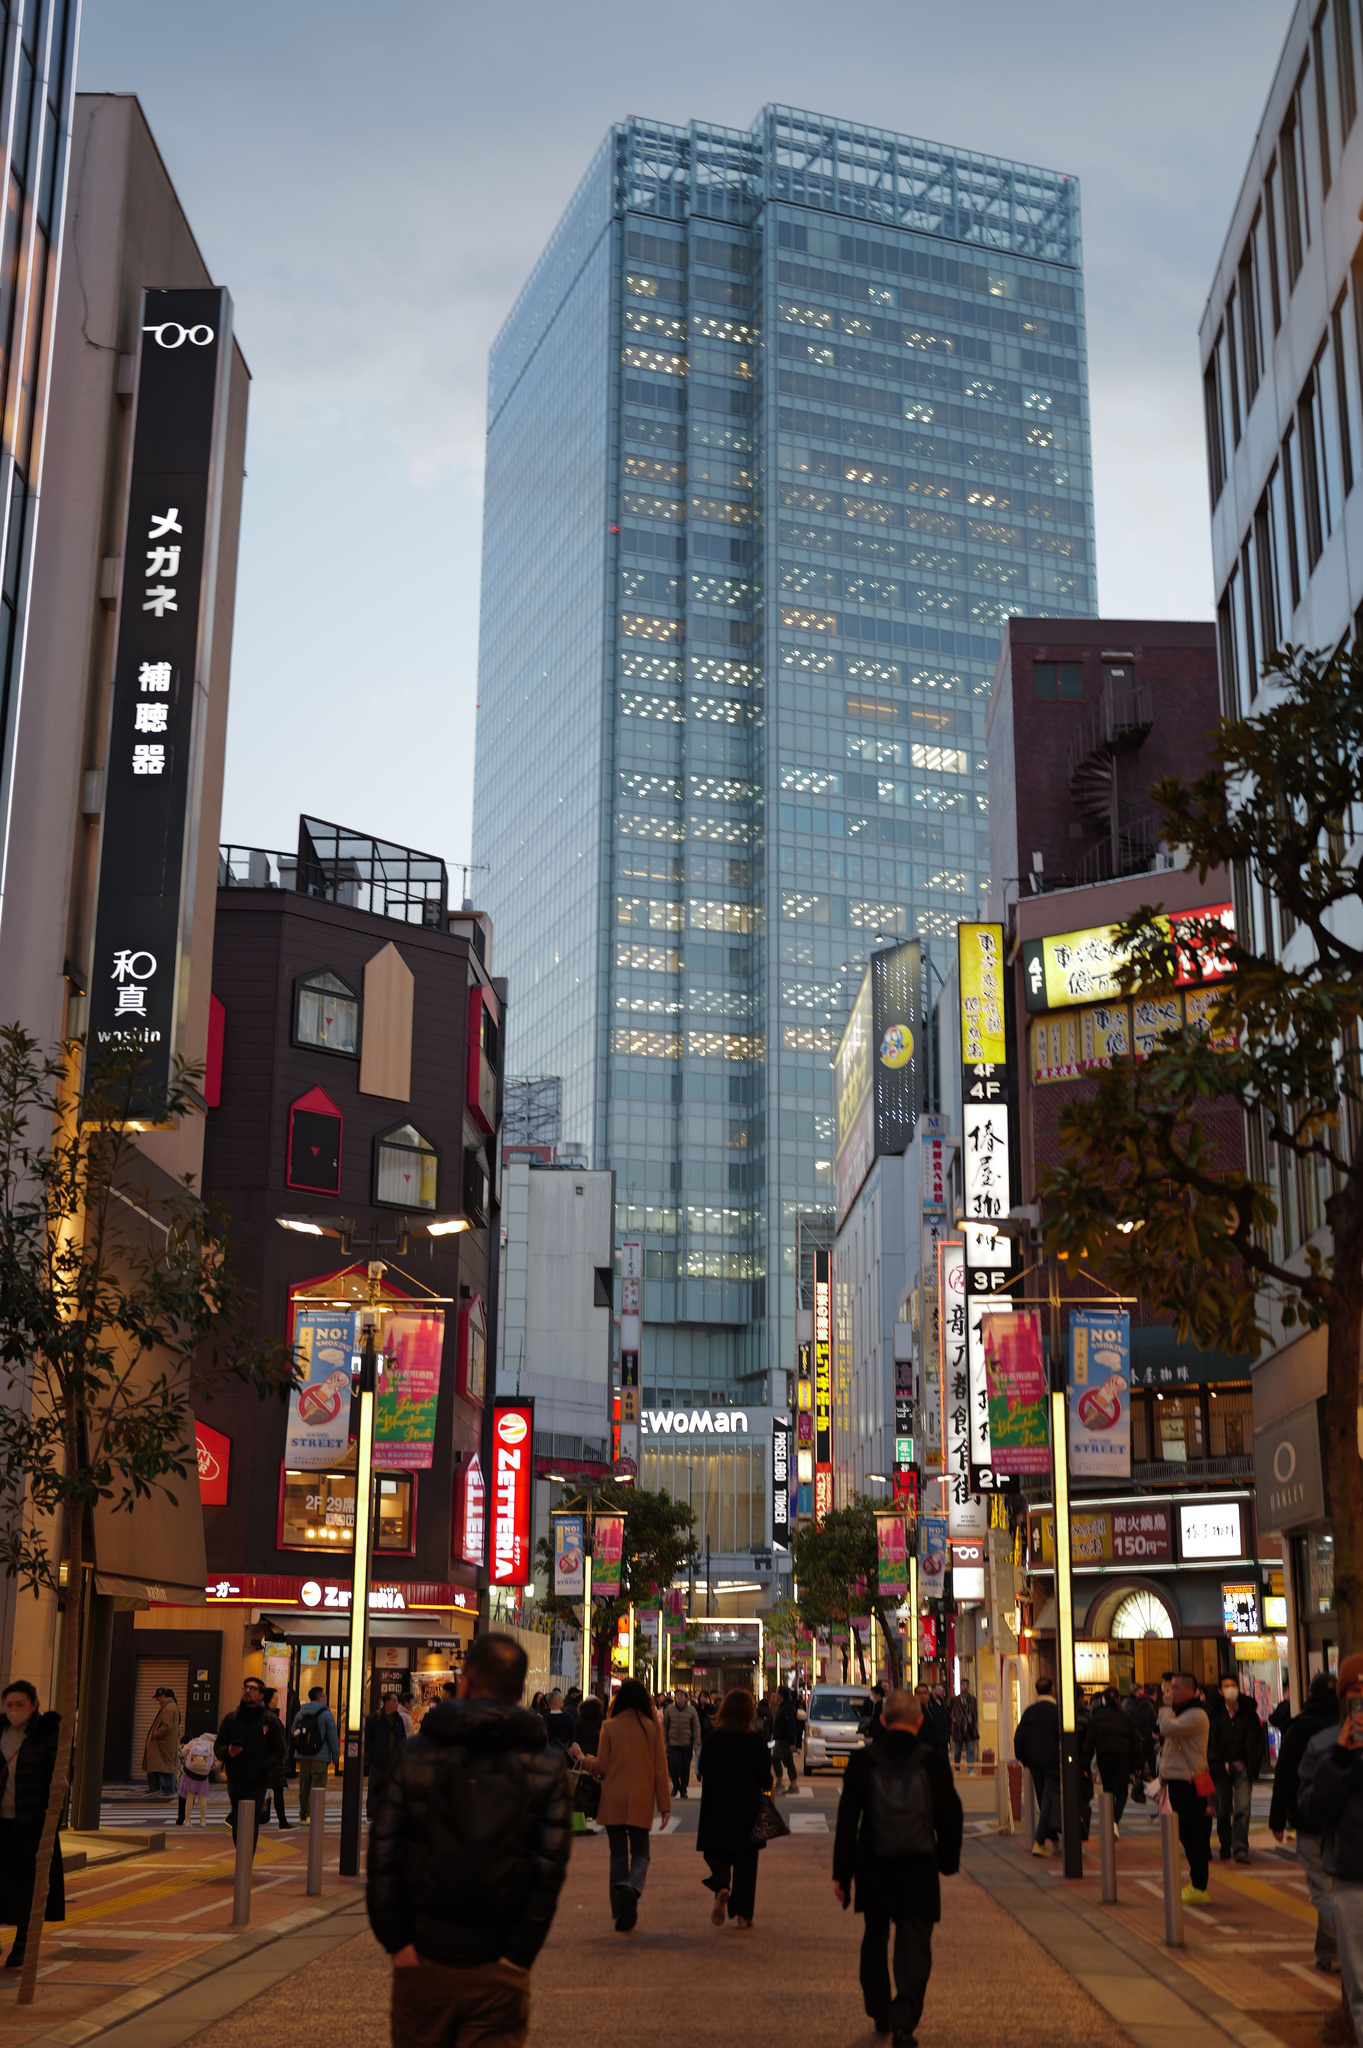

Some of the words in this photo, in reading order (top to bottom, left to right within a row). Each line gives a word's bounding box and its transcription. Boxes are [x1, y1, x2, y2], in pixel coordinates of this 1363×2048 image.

[142, 508, 182, 617] メガネ
[132, 662, 172, 775] 補聴器
[110, 949, 157, 1017] 和真
[973, 1063, 995, 1077] 4F
[969, 1080, 1000, 1100] 4F
[973, 1271, 1006, 1291] 3F
[316, 1327, 348, 1340] NO!
[1090, 1328, 1123, 1344] NO!
[315, 1340, 353, 1353] SMOKING
[1090, 1342, 1129, 1356] SMOKING
[291, 1438, 343, 1448] STREET
[1074, 1443, 1126, 1454] STREET
[774, 1431, 787, 1482] PASELABO
[305, 1495, 323, 1510] 2F
[774, 1488, 787, 1525] TOWER
[495, 1448, 521, 1579] ZETTERIA
[1114, 1514, 1166, 1533] 炭火焼鳥
